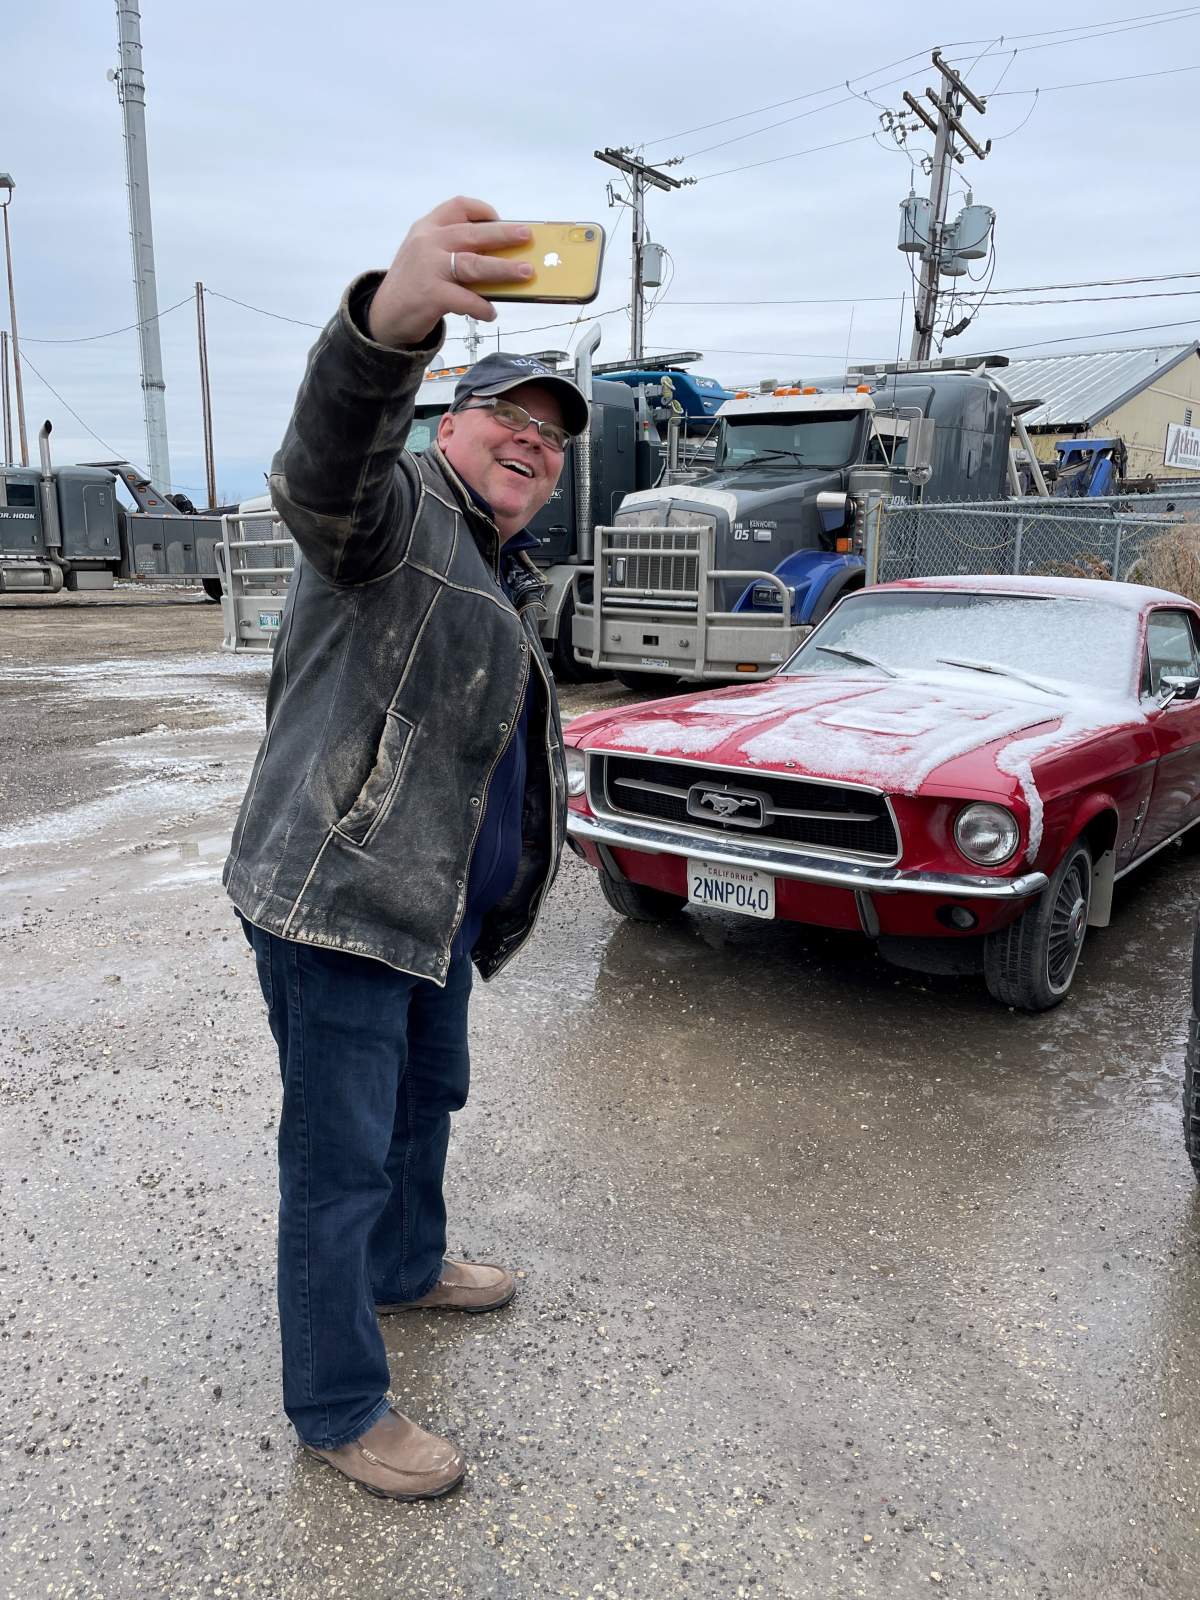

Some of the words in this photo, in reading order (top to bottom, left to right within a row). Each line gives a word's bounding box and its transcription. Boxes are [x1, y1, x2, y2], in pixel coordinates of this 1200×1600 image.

[734, 529, 750, 541] 05
[708, 866, 754, 882] CALIFORNIA
[693, 876, 769, 912] 2NNP040
